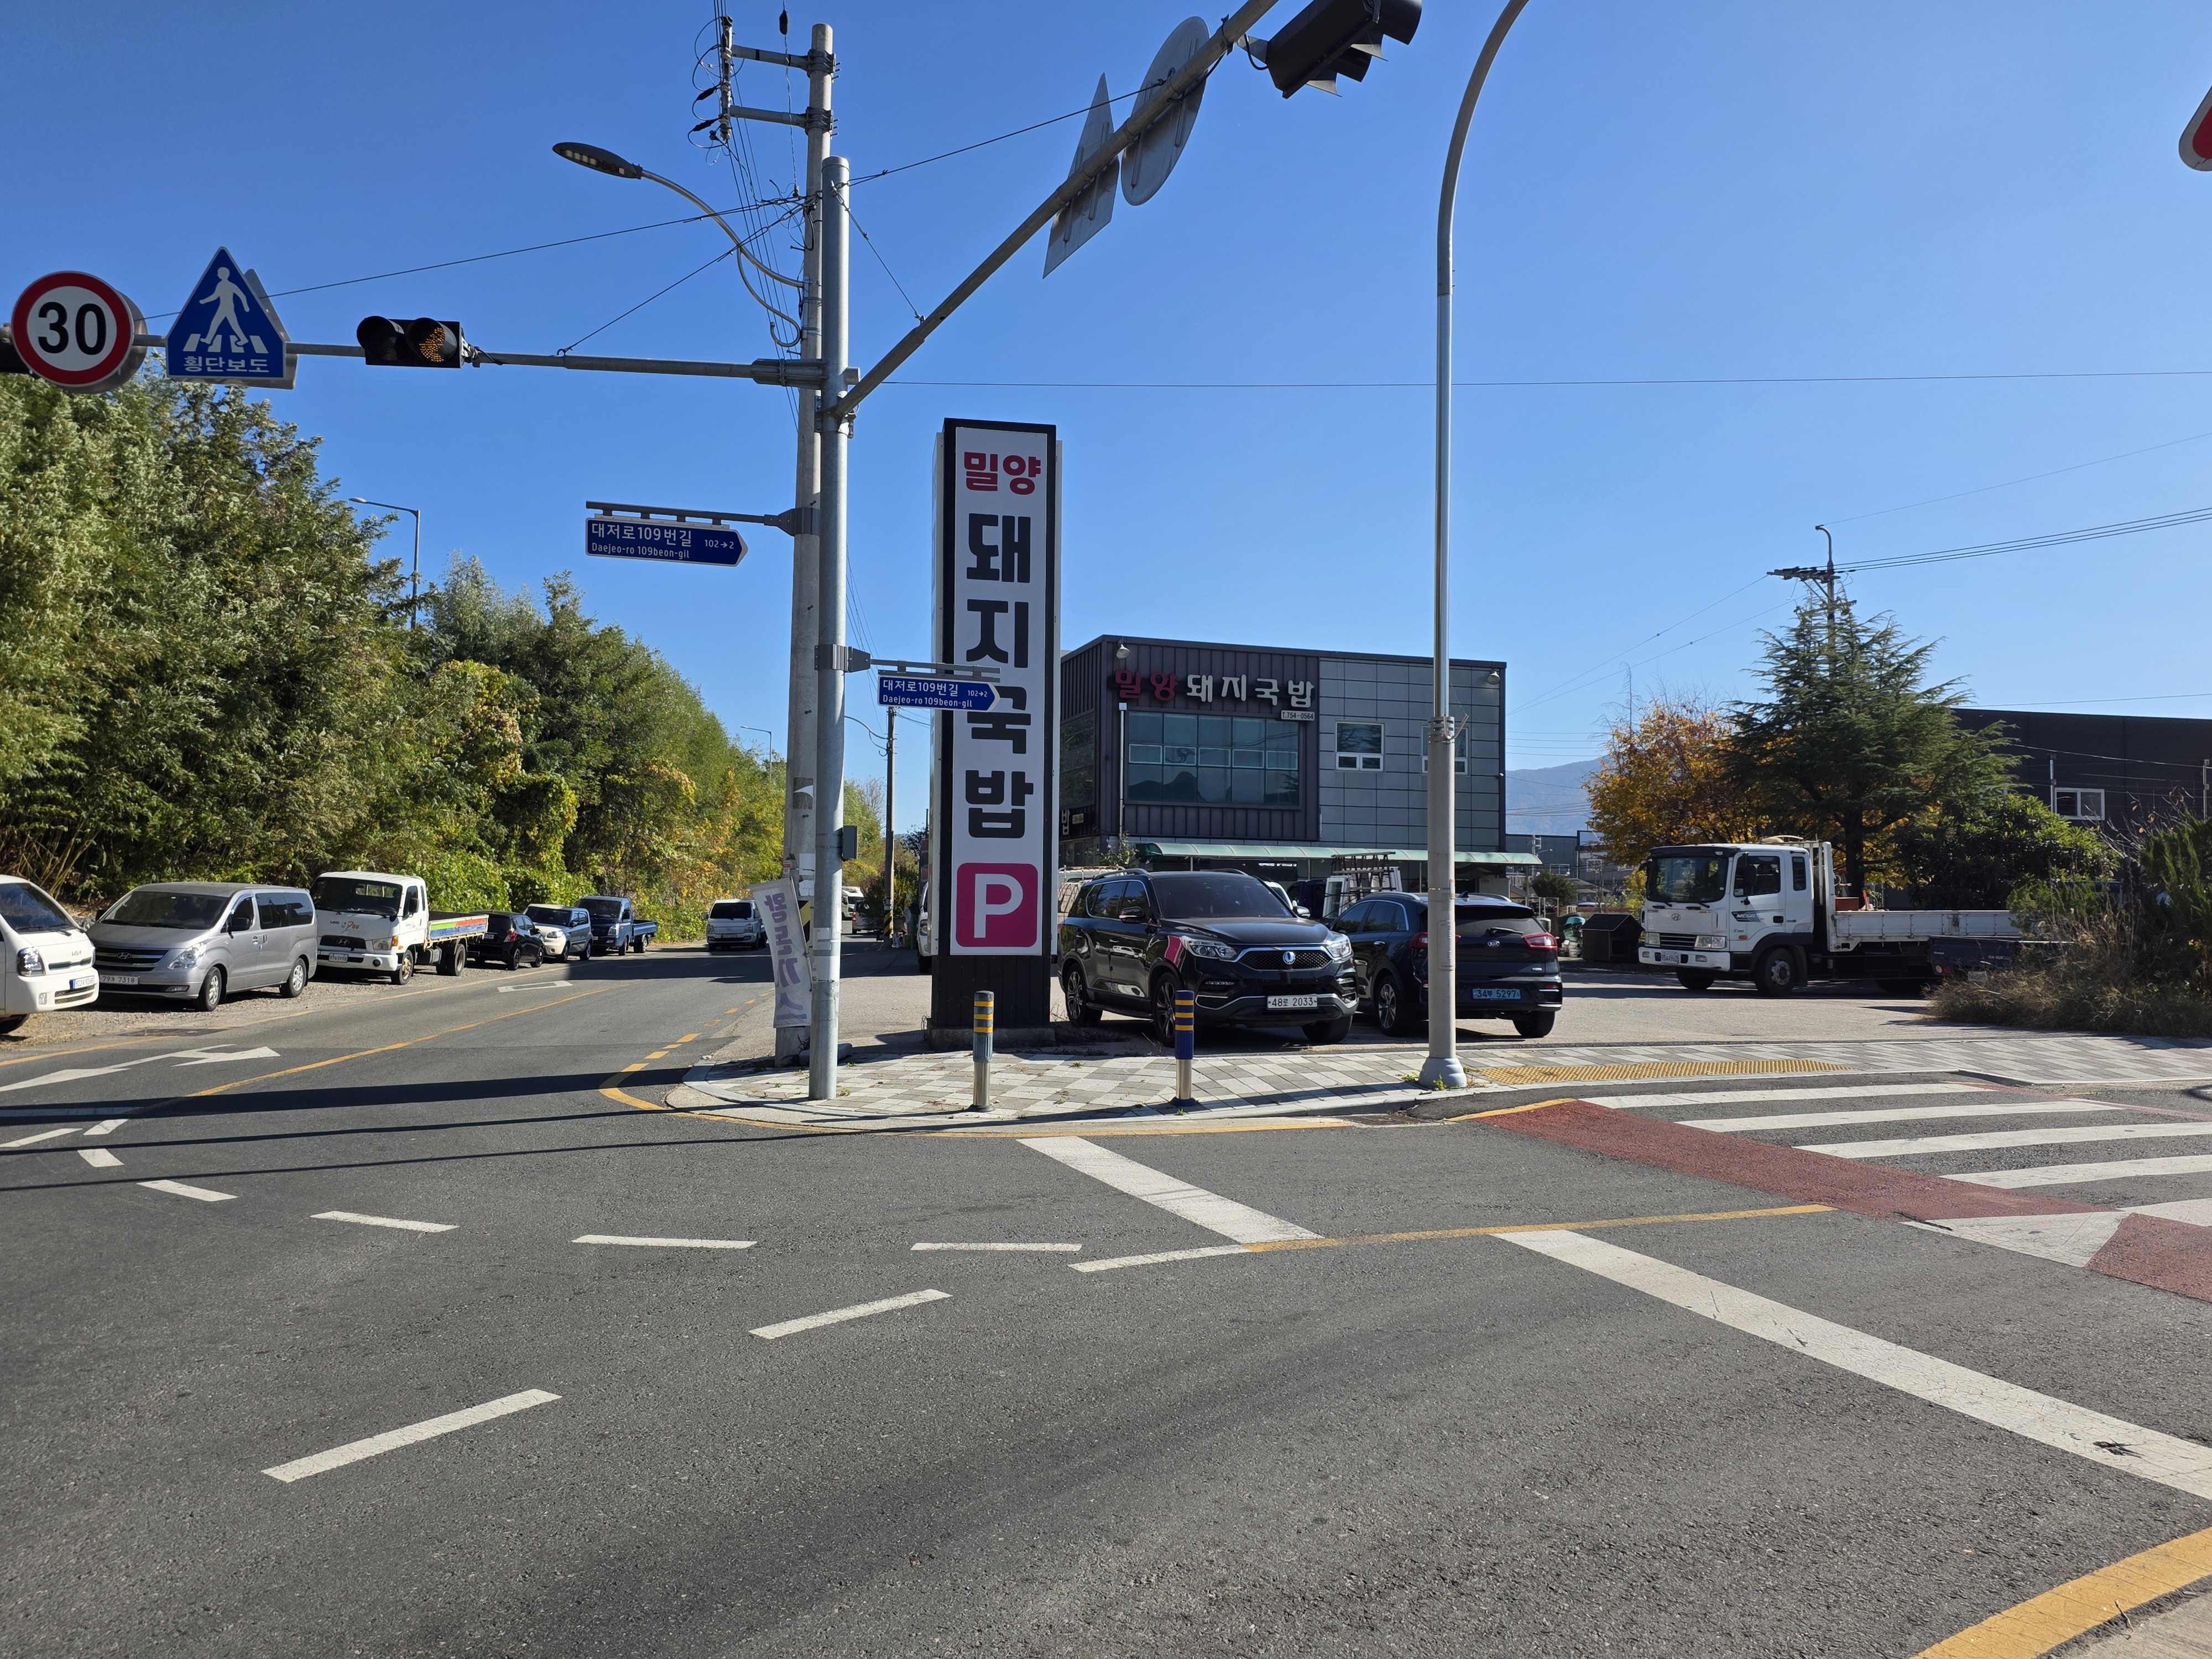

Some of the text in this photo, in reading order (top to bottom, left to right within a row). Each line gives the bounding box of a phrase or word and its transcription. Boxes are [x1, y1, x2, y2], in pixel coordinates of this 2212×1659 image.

[38, 301, 107, 356] 30
[184, 356, 270, 373] 횡단보도
[963, 451, 1041, 495] 밀양
[592, 523, 692, 547] 대저로109번길
[592, 542, 690, 560] Daejeo-ro 109beon-gil
[883, 680, 958, 697] 대저로109번길
[1115, 669, 1315, 708] 밀양 돼지국밥
[883, 695, 973, 708] Daejeo-ro 109beon-gil
[1282, 712, 1314, 720] T.754-0564
[974, 873, 1024, 938] P
[1272, 997, 1313, 1006] 48로 2033
[1496, 989, 1516, 998] 5297
